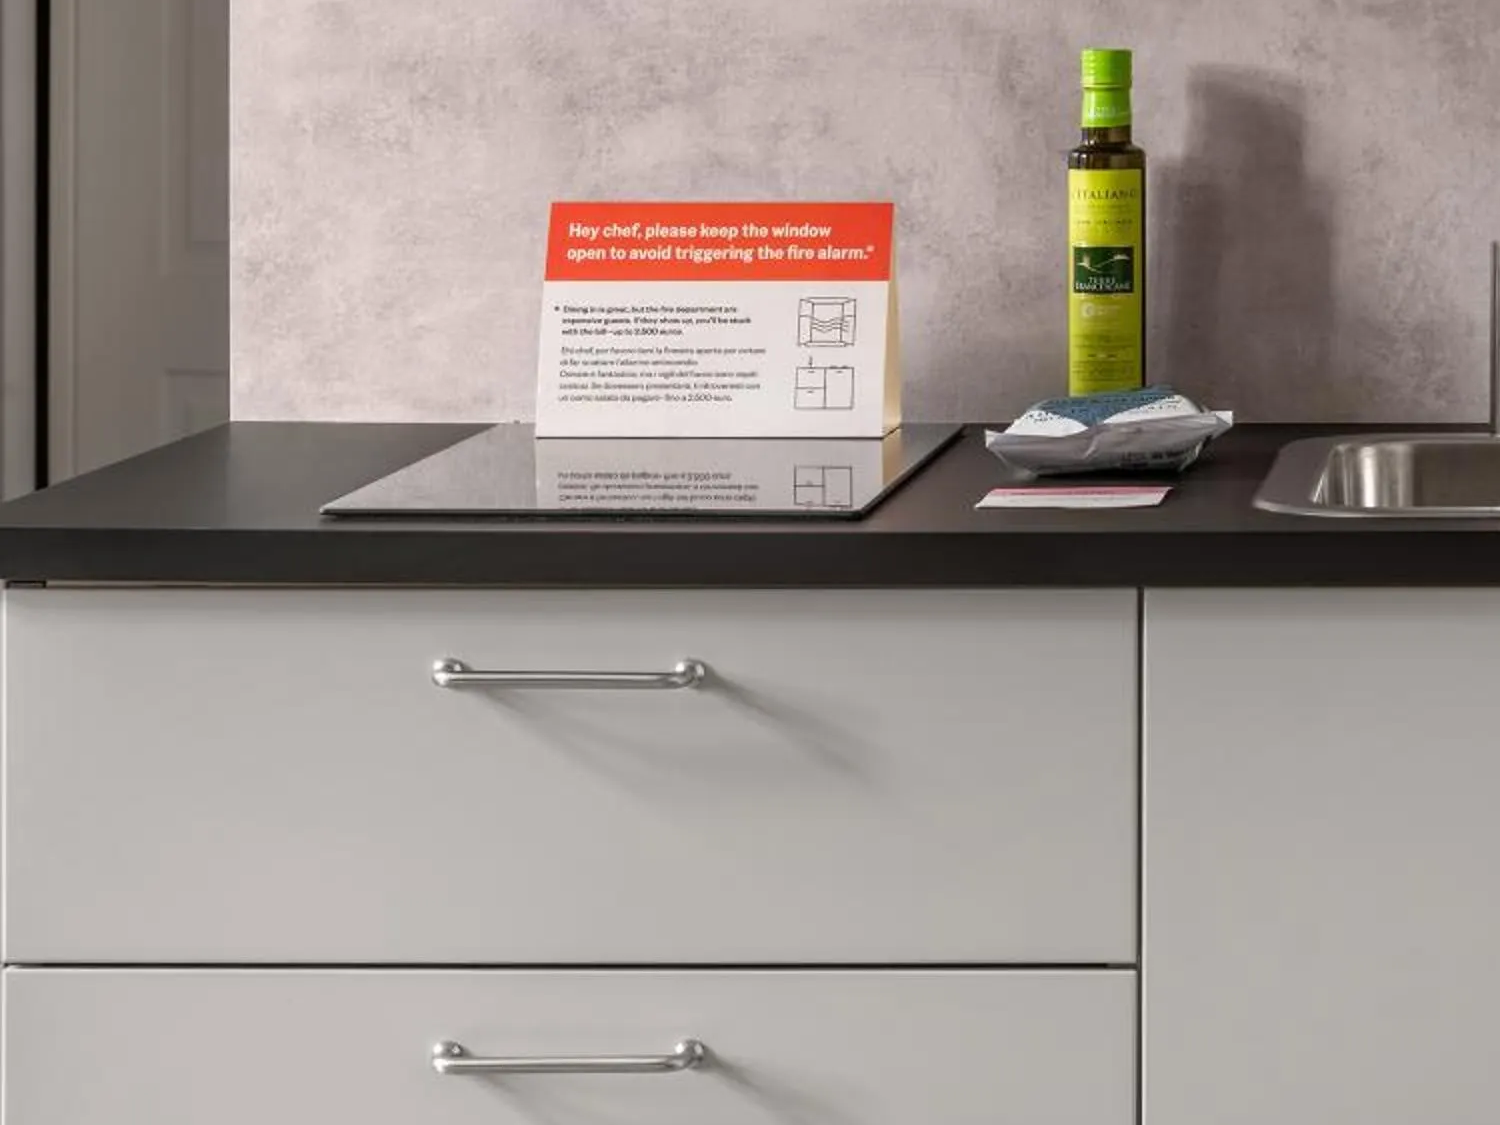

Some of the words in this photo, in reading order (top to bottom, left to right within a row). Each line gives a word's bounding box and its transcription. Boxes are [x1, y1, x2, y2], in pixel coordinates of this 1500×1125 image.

[569, 223, 598, 240] Hey
[602, 222, 642, 239] chef,
[645, 222, 696, 240] please
[700, 222, 738, 240] keep
[742, 222, 769, 237] the
[772, 222, 832, 237] window
[567, 247, 604, 262] open
[609, 246, 625, 259] to
[629, 244, 671, 259] avoid
[675, 244, 753, 262] triggering
[757, 244, 783, 259] the
[787, 244, 814, 259] fire
